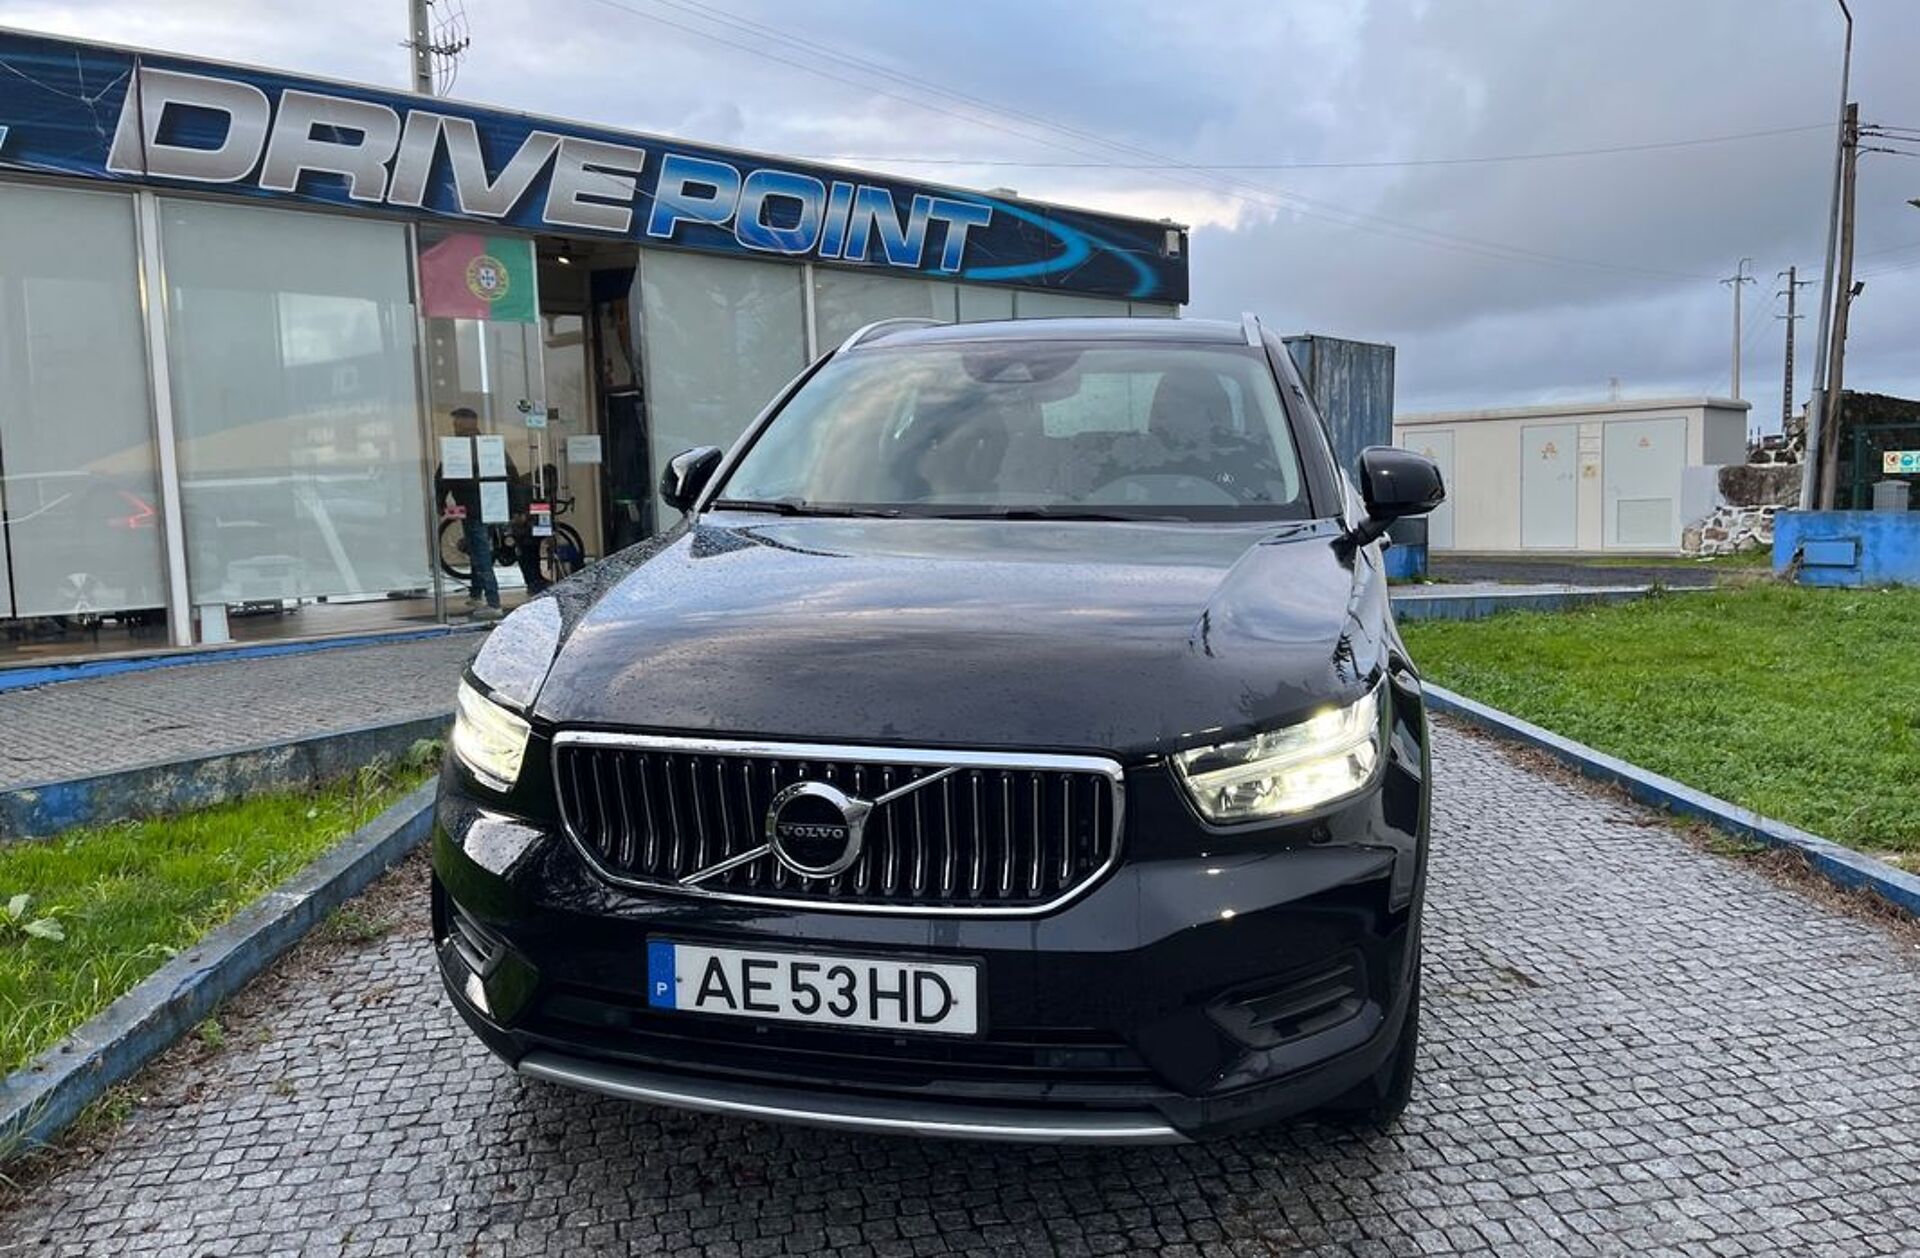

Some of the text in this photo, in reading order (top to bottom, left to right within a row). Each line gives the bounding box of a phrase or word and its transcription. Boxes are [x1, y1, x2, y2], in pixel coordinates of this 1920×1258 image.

[106, 66, 993, 272] DRIVE POINT
[779, 825, 844, 839] VOLVO
[656, 982, 668, 996] P
[696, 957, 952, 1024] AE53HD
